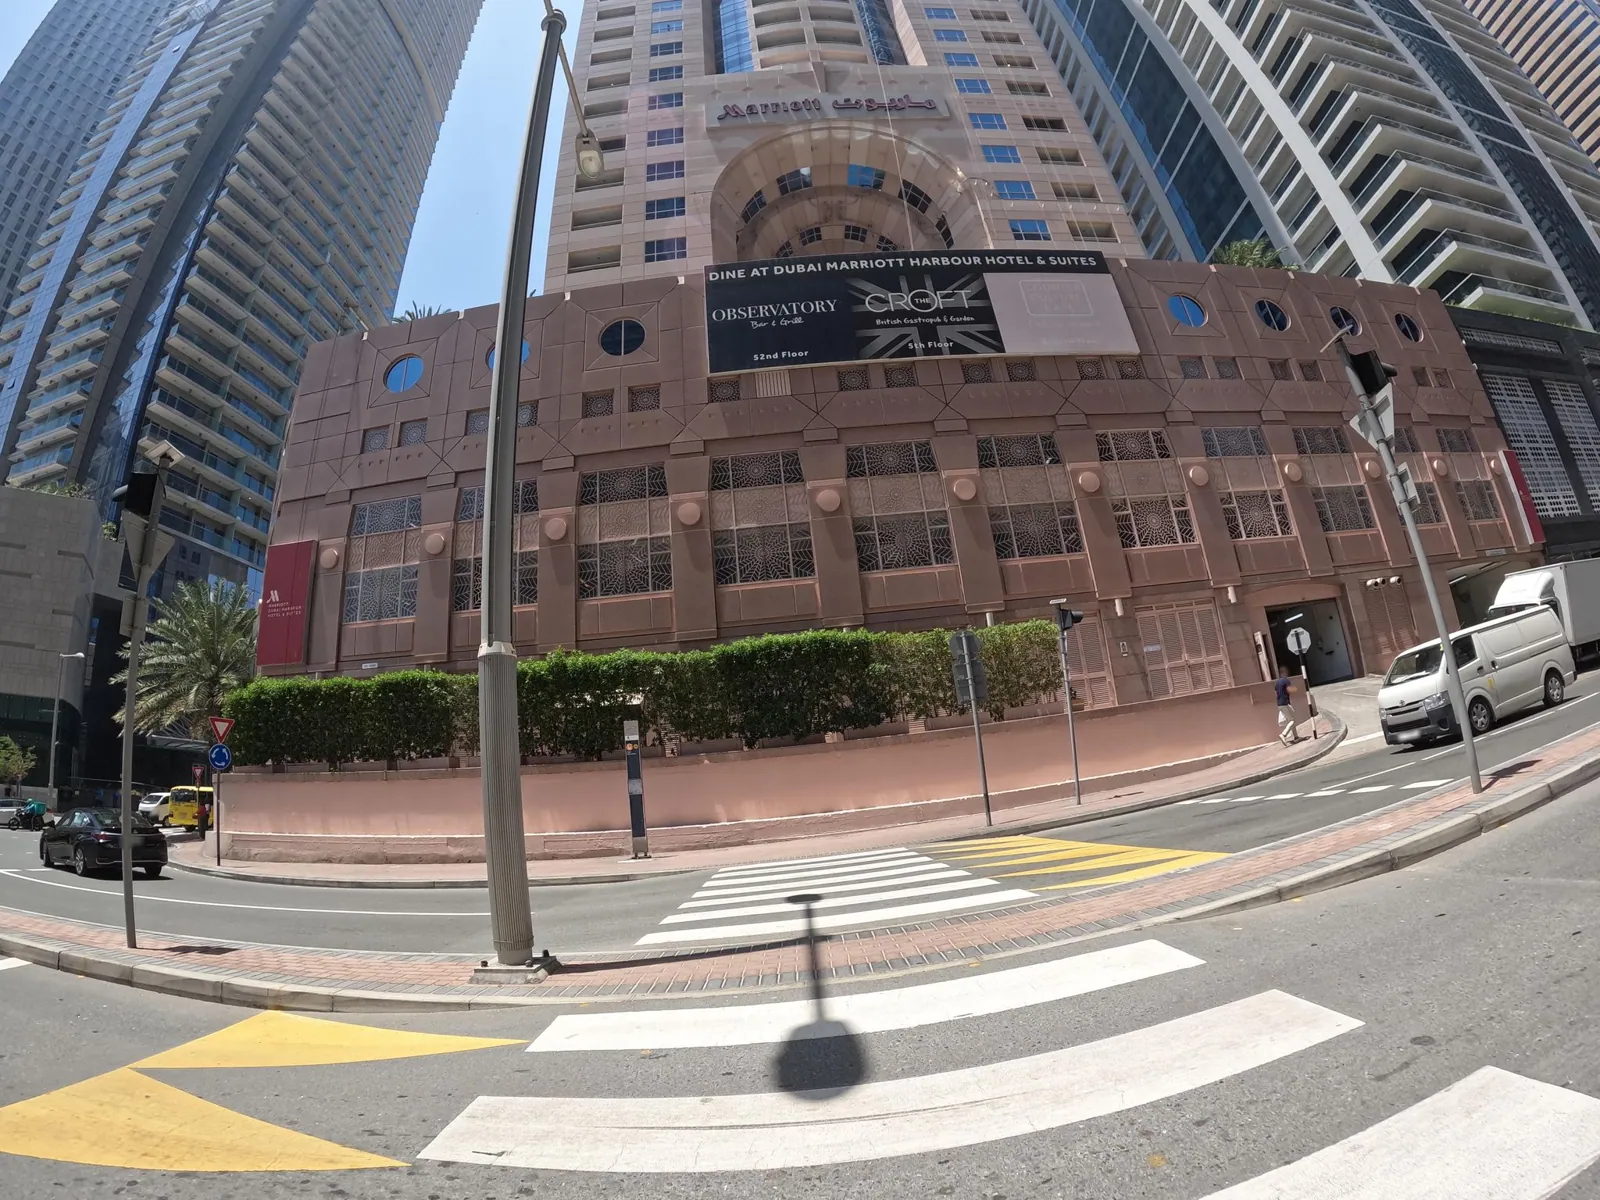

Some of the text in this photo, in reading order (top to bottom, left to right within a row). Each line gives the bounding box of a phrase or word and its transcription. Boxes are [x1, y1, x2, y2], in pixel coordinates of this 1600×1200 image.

[717, 98, 821, 120] Marriott
[709, 256, 1097, 281] DINE AT DUBAI MARRIOTT HARBOUR HOTEL & SUITES
[865, 289, 971, 312] CROFT
[712, 299, 837, 322] OBSERVATORY
[750, 320, 769, 329] Bar
[780, 316, 804, 326] Grill
[875, 317, 902, 326] British
[903, 315, 941, 325] Gastropub
[908, 341, 954, 349] 5th Floor
[753, 350, 809, 361] 52nd Floor
